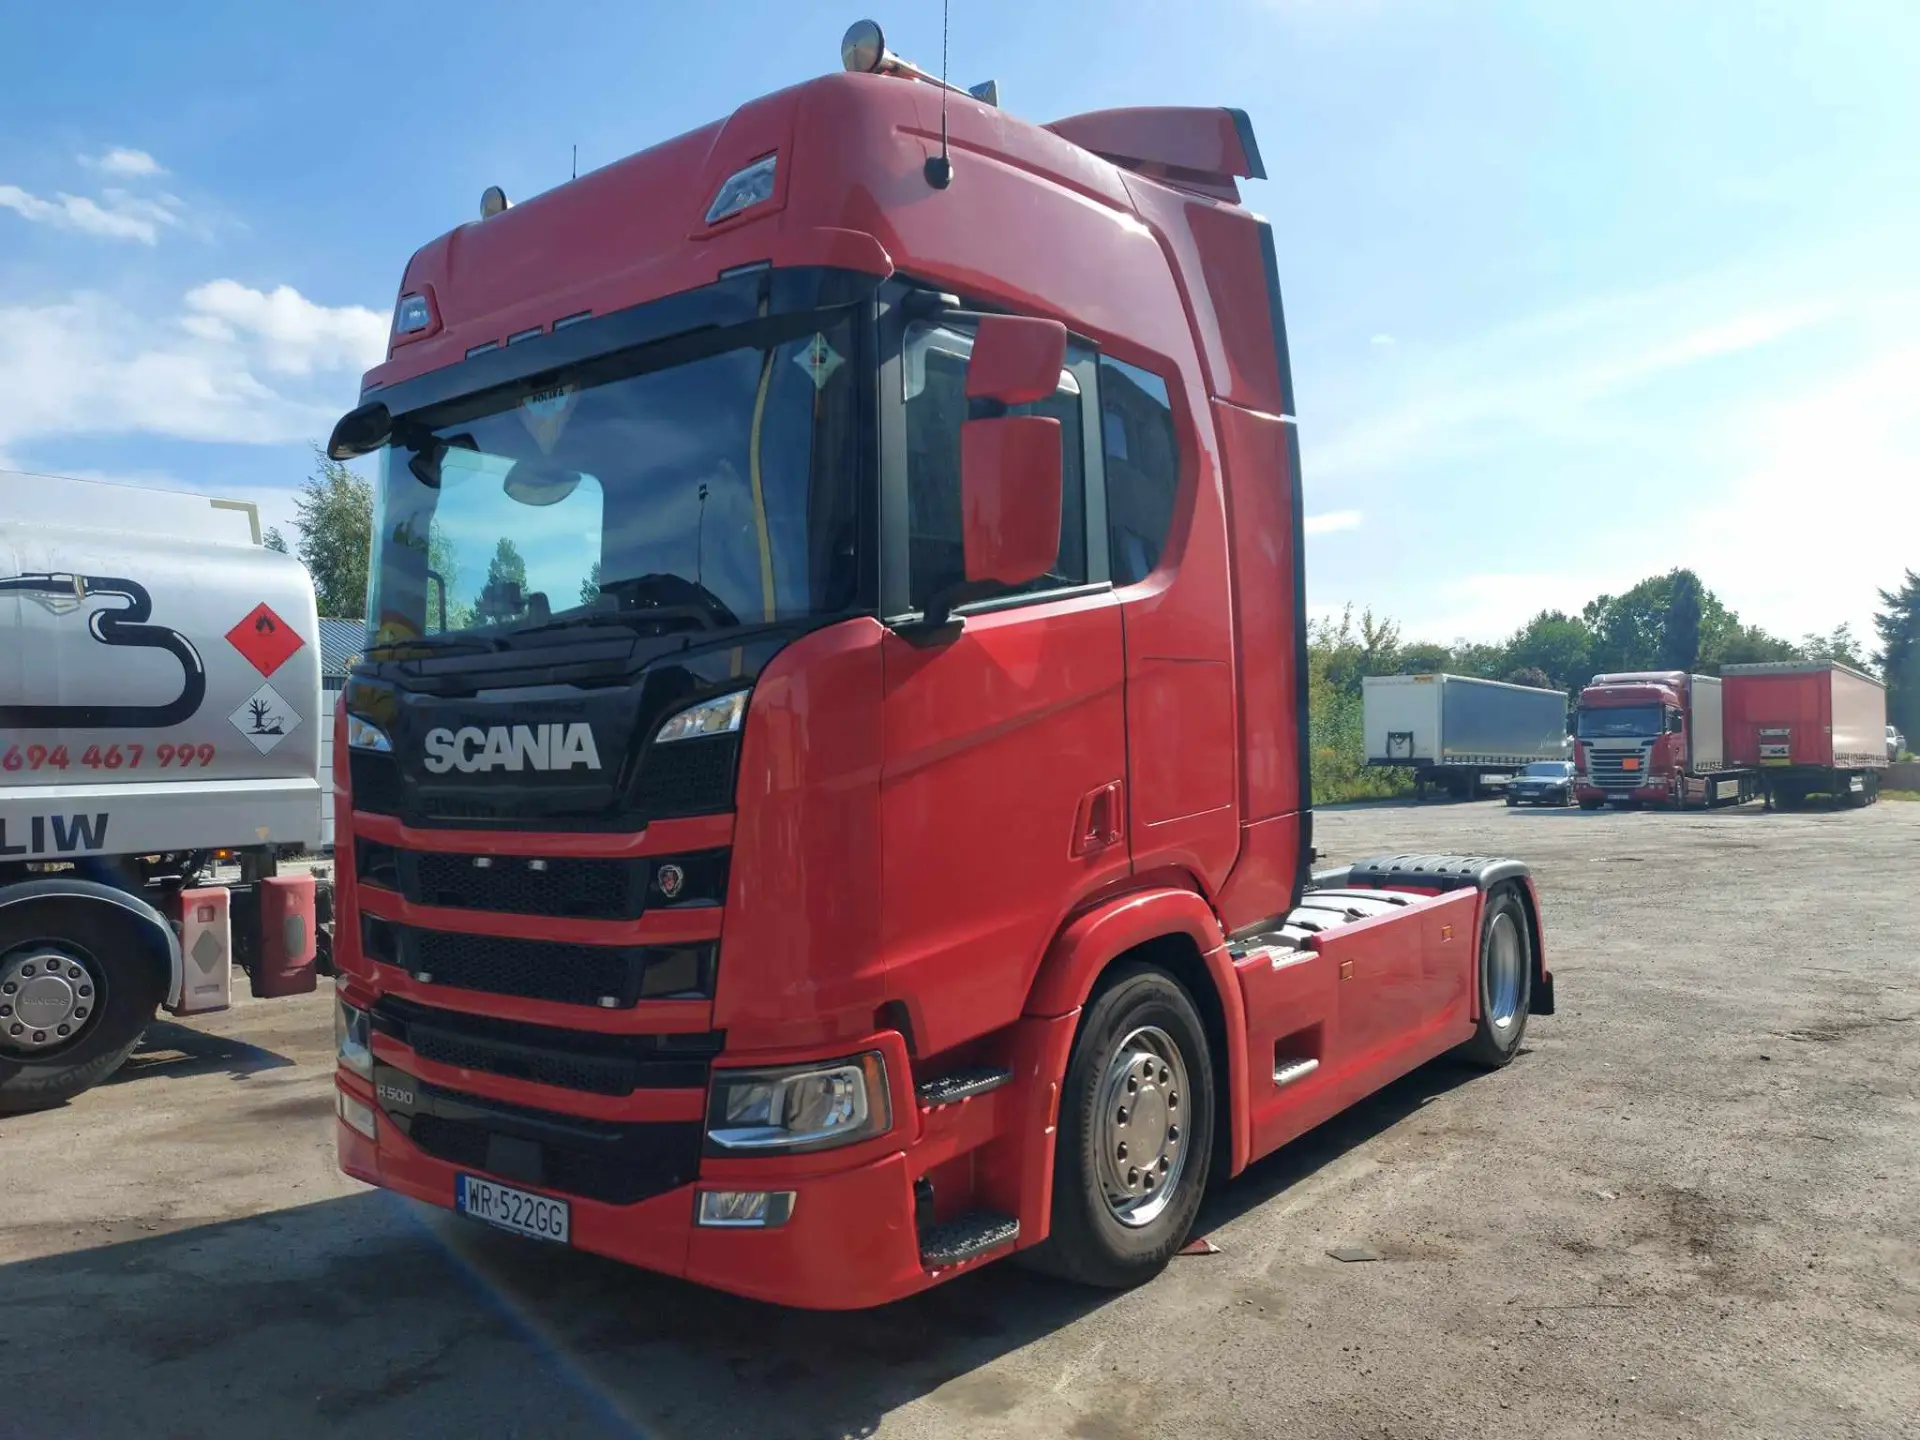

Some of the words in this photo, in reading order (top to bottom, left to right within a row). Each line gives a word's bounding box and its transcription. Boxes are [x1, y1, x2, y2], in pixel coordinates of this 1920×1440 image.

[3, 744, 69, 771] 694
[81, 745, 145, 769] 467
[157, 743, 215, 768] 999
[424, 722, 602, 774] SCANIA
[0, 813, 109, 855] LIW
